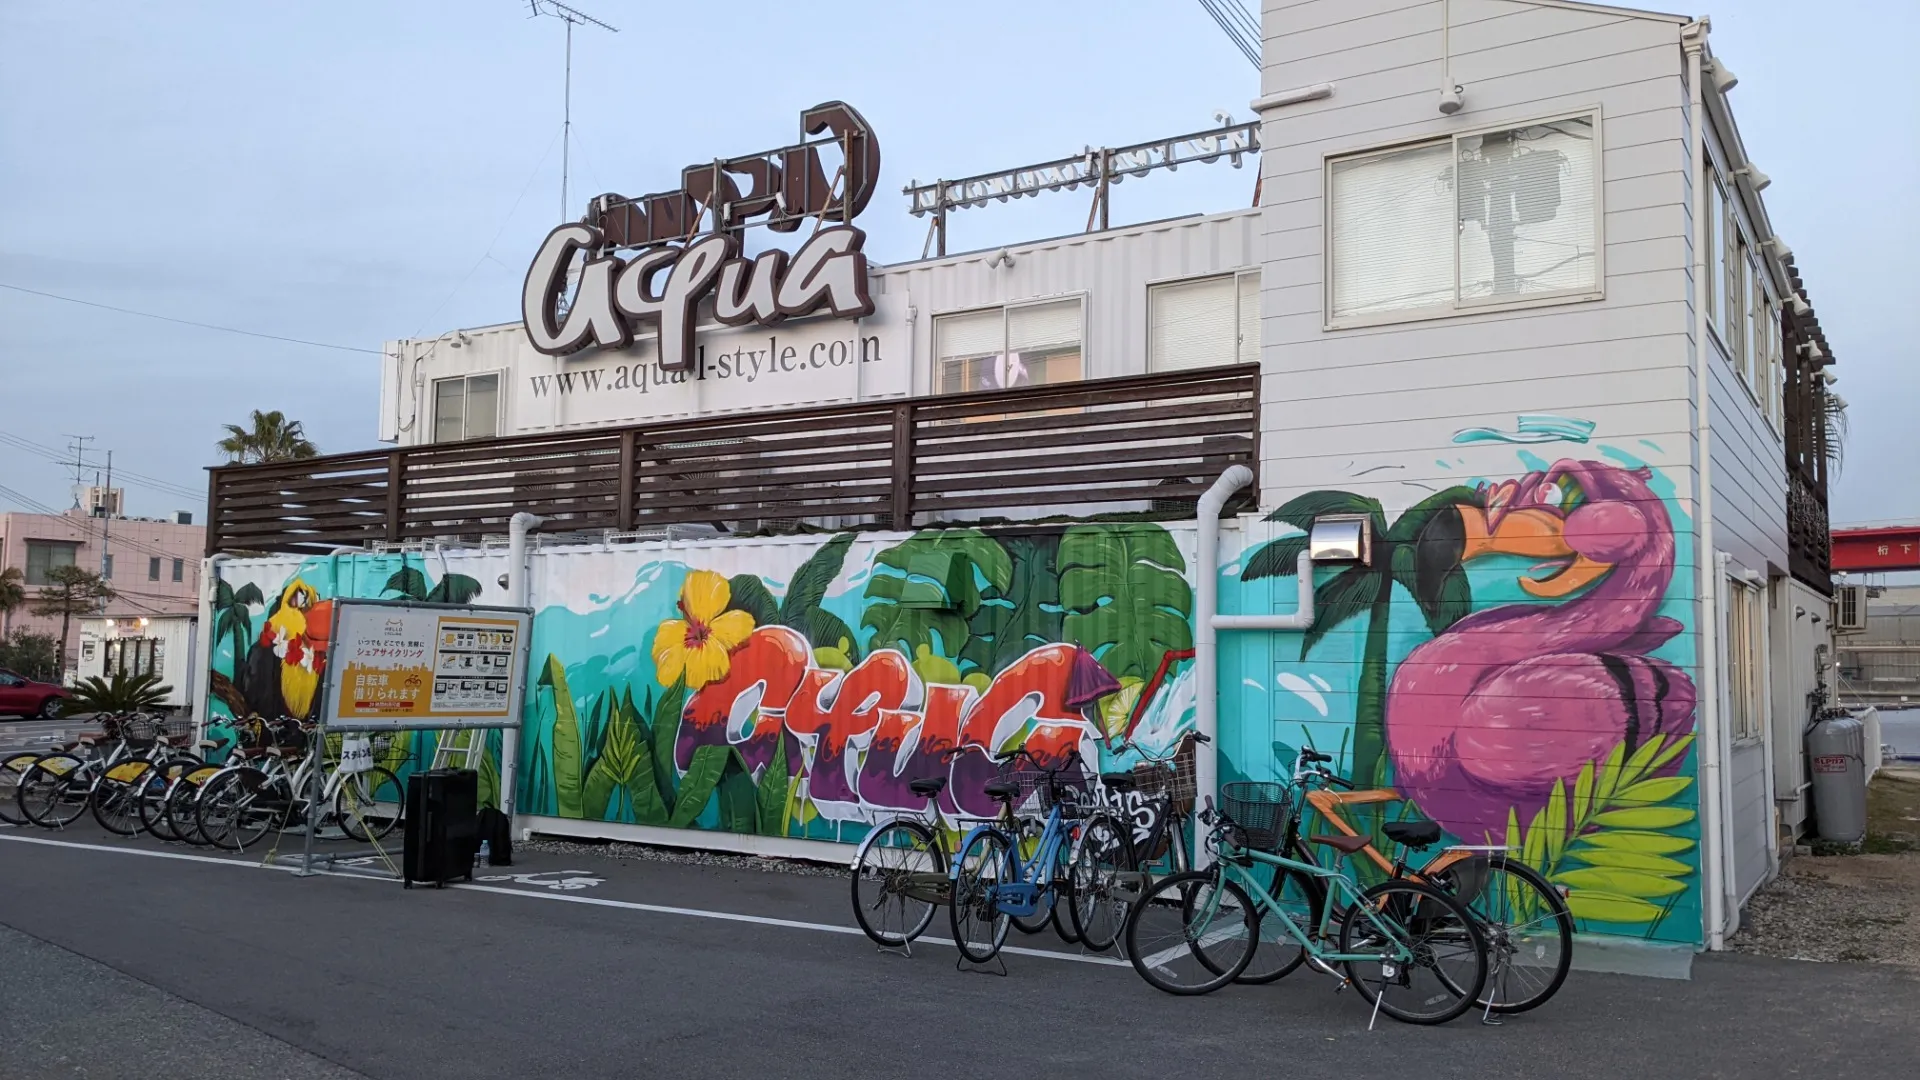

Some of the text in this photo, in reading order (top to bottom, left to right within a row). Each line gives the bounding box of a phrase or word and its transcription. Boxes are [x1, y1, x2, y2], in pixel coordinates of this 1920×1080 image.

[357, 647, 424, 658] シェアサイクリング
[355, 674, 389, 687] 自転車
[353, 687, 420, 700] 借りられます
